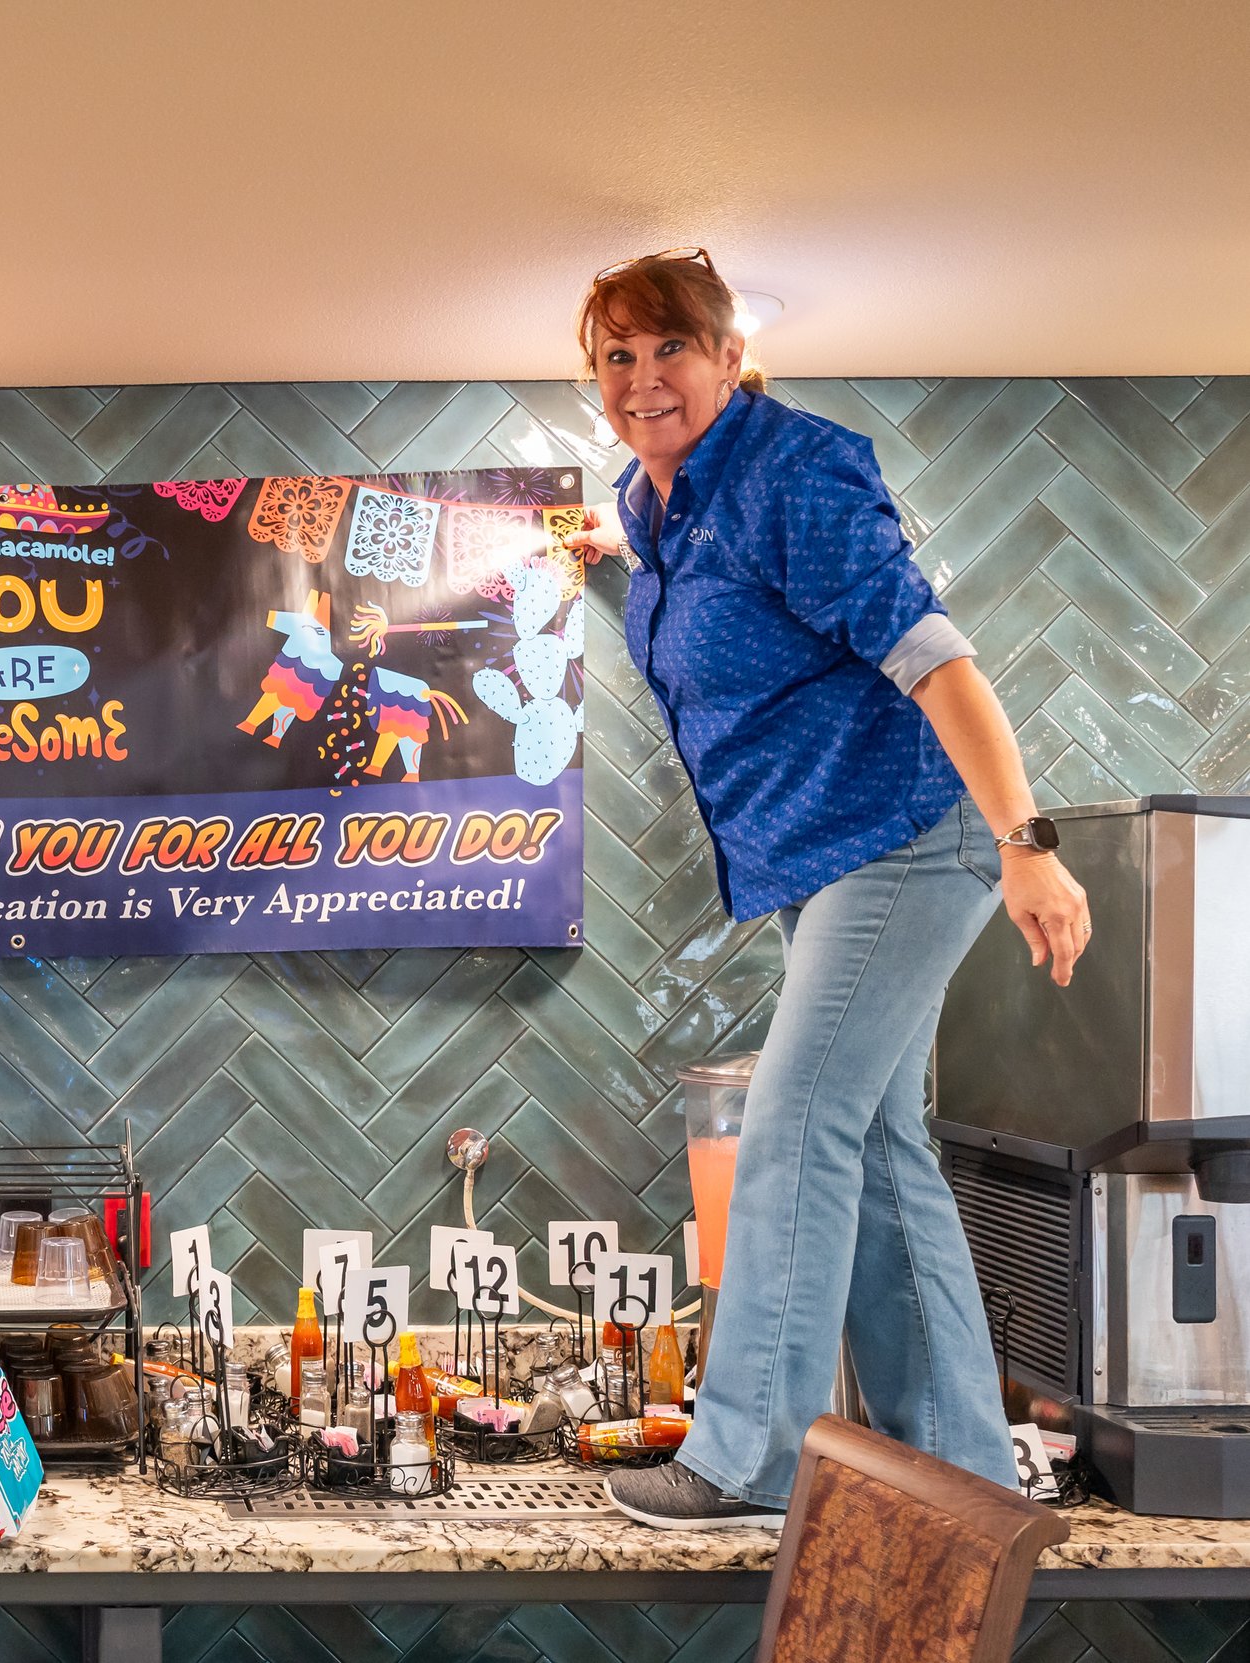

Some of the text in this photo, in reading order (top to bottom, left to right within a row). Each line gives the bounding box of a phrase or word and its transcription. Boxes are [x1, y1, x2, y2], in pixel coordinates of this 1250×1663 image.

[7, 816, 123, 874] YOU
[120, 814, 231, 874] FOR
[229, 812, 323, 871] ALL
[336, 810, 449, 867] YOU
[450, 808, 562, 866] DO!
[119, 888, 152, 921] is
[167, 886, 252, 926] Very
[263, 878, 527, 924] Appreciated!
[188, 1239, 200, 1281] 1
[335, 1254, 348, 1300] 7
[558, 1231, 608, 1275] 10
[464, 1255, 509, 1302] 12
[609, 1265, 657, 1313] 11
[209, 1280, 221, 1330] 3
[366, 1279, 387, 1328] 5
